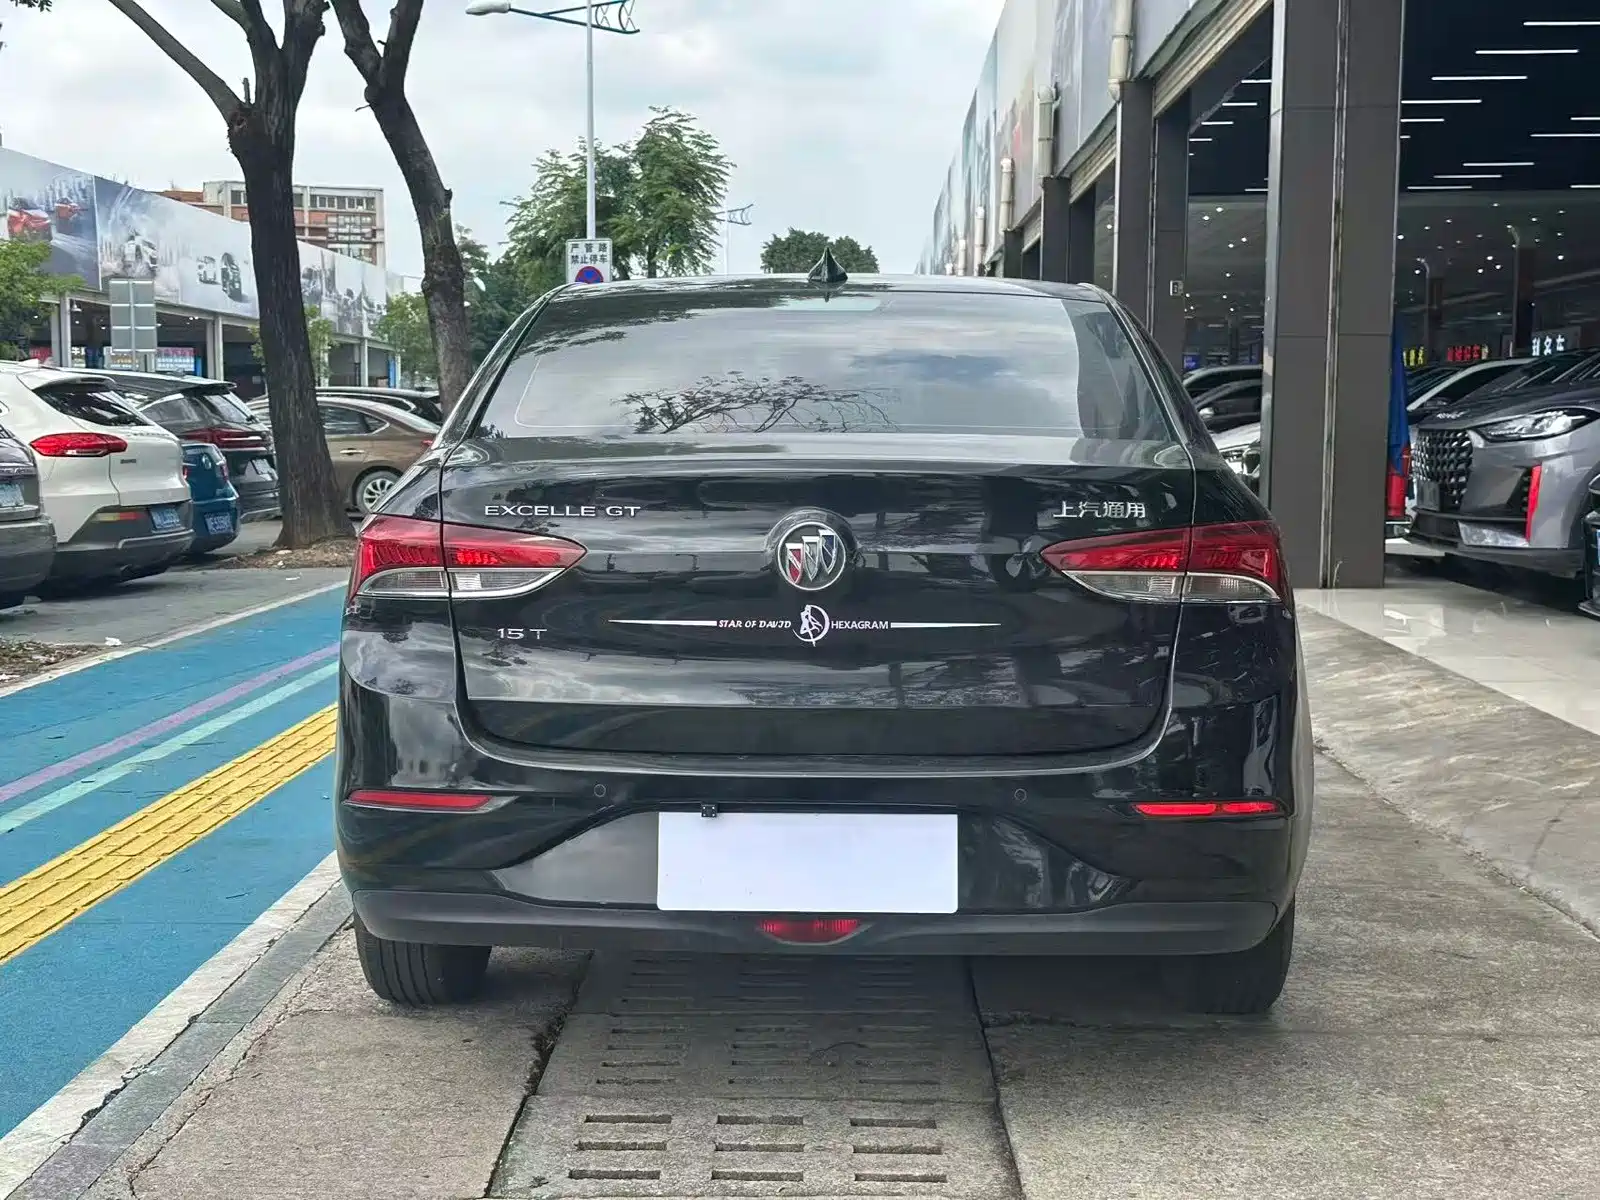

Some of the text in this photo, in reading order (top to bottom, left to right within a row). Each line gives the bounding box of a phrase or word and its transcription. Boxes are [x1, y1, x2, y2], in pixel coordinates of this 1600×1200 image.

[571, 254, 608, 265] 禁止停车
[484, 505, 641, 517] EXCELLE GT
[1052, 500, 1146, 519] 上汽通用
[718, 619, 743, 628] STAR
[744, 619, 757, 628] OF
[830, 620, 889, 630] HEXAGRAM
[497, 628, 548, 640] 15 T
